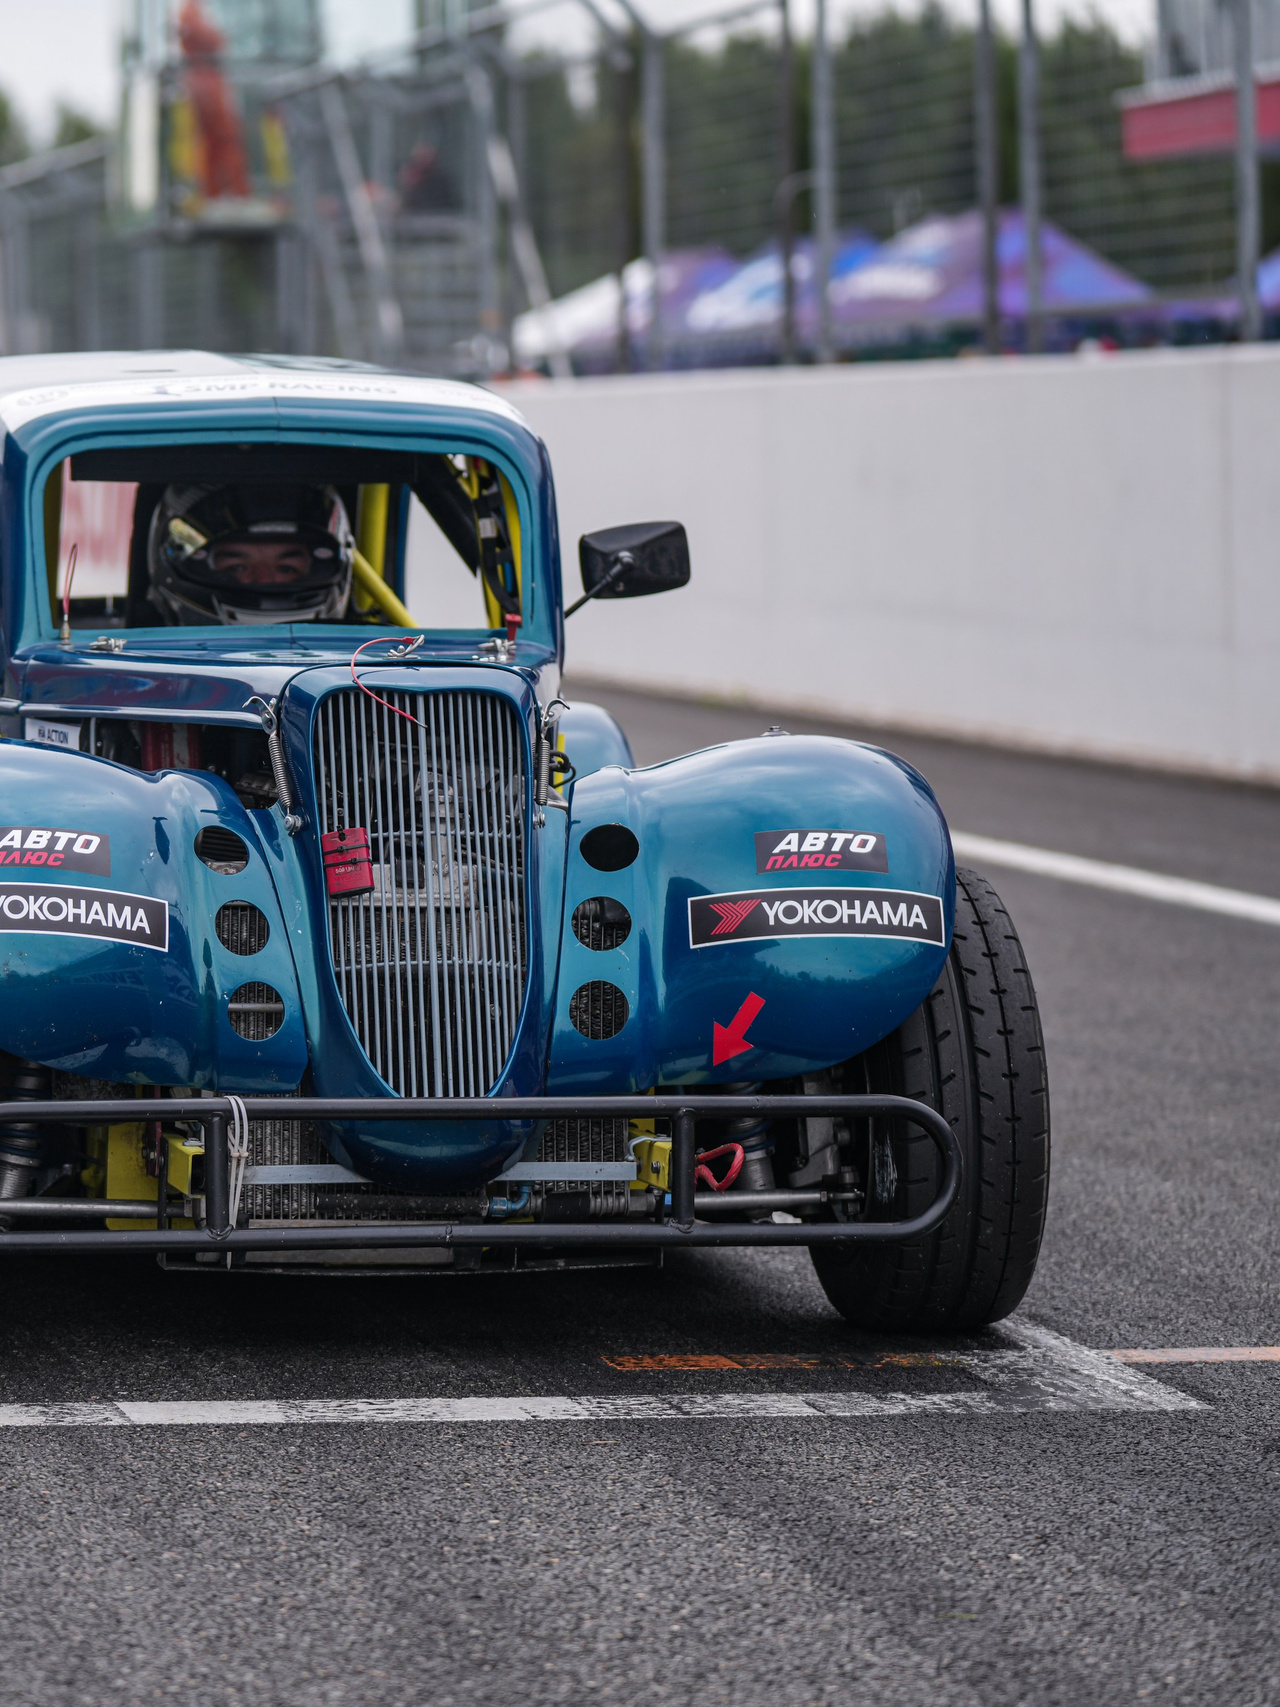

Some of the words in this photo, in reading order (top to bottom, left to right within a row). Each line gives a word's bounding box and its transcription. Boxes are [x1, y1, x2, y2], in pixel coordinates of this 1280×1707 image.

[185, 383, 258, 393] SMP
[268, 382, 397, 394] RACING
[47, 728, 69, 745] ACTION
[772, 832, 877, 854] АВТО
[765, 853, 842, 870] ПЛЮС
[761, 900, 928, 930] YOKOHAMA
